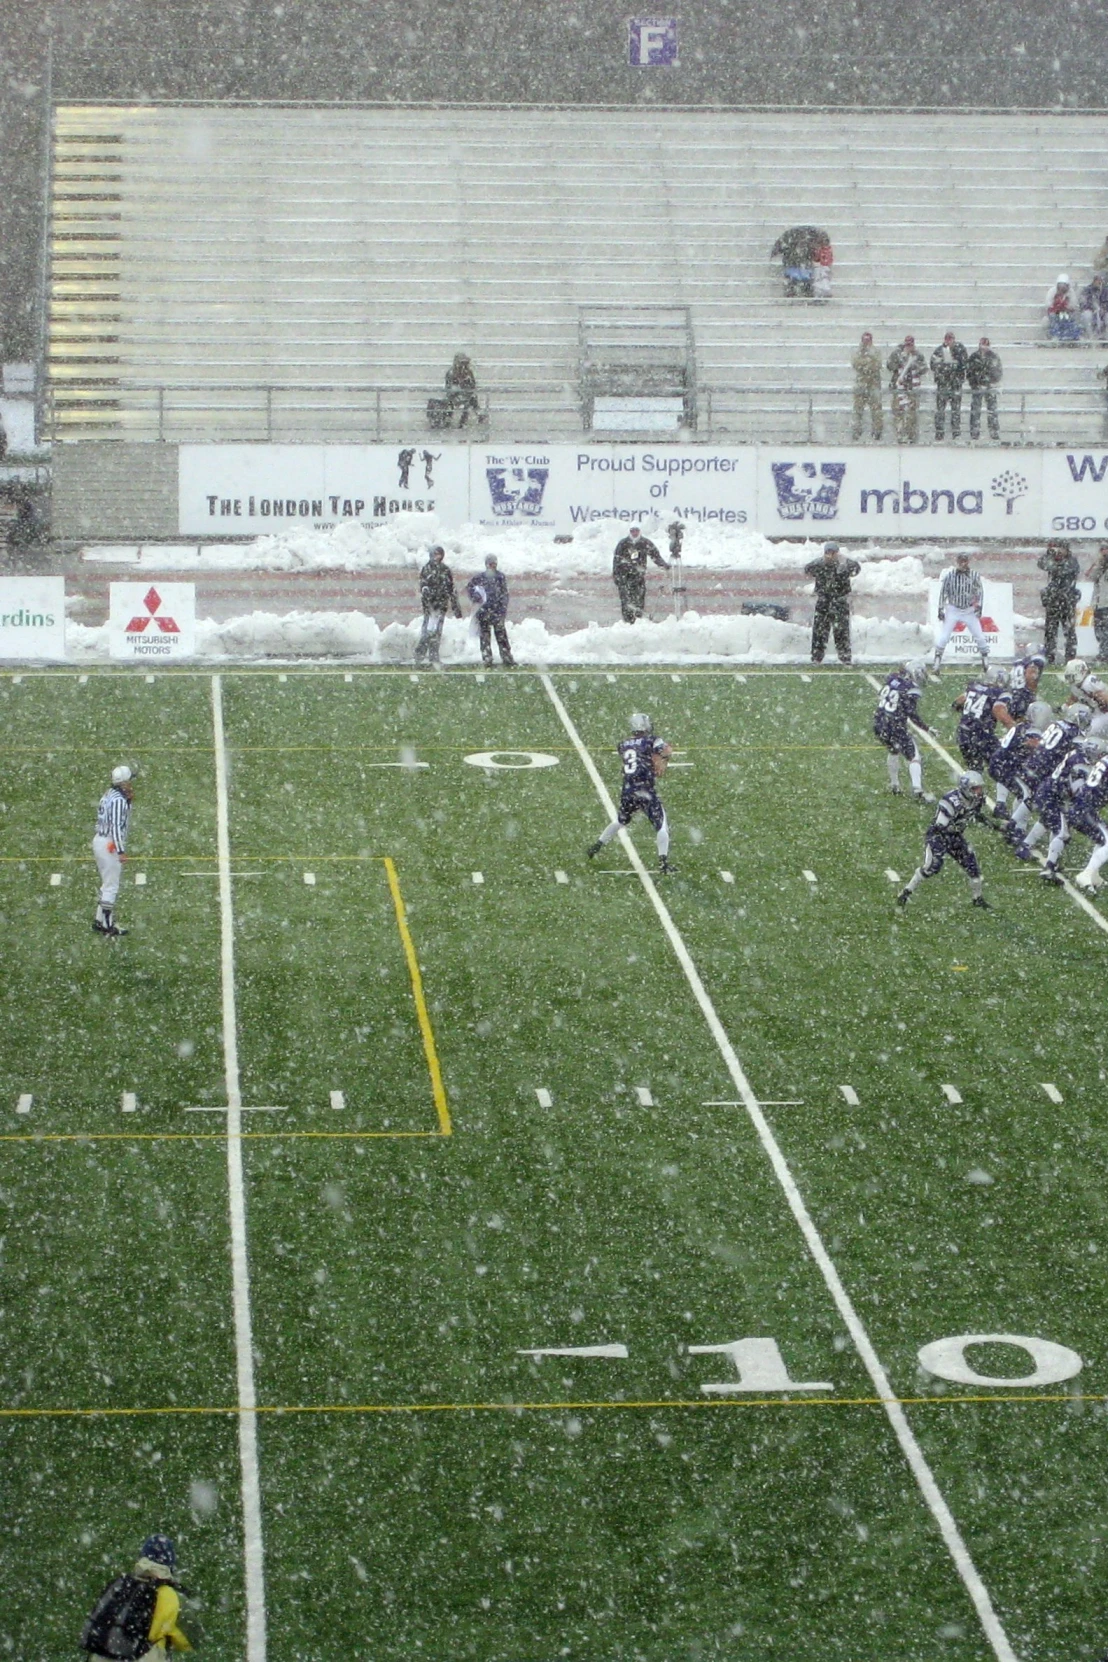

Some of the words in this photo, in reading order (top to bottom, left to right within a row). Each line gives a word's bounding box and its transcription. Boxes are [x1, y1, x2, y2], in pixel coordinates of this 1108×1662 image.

[640, 27, 666, 64] F
[486, 456, 505, 465] The
[525, 456, 550, 465] Club
[577, 454, 638, 472] Proud
[642, 454, 739, 479] Supporter
[649, 481, 670, 498] of
[860, 480, 983, 515] mbna
[206, 495, 242, 517] THE
[249, 495, 323, 517] LONDON
[328, 495, 365, 517] TAP
[373, 495, 437, 517] HOUSE
[570, 505, 661, 523] Western's
[673, 505, 748, 523] Athletes
[0, 609, 56, 627] rdins
[126, 635, 178, 645] MITSUBISHI
[133, 646, 171, 655] MOTORS
[963, 690, 989, 718] 54
[624, 749, 637, 774] 3
